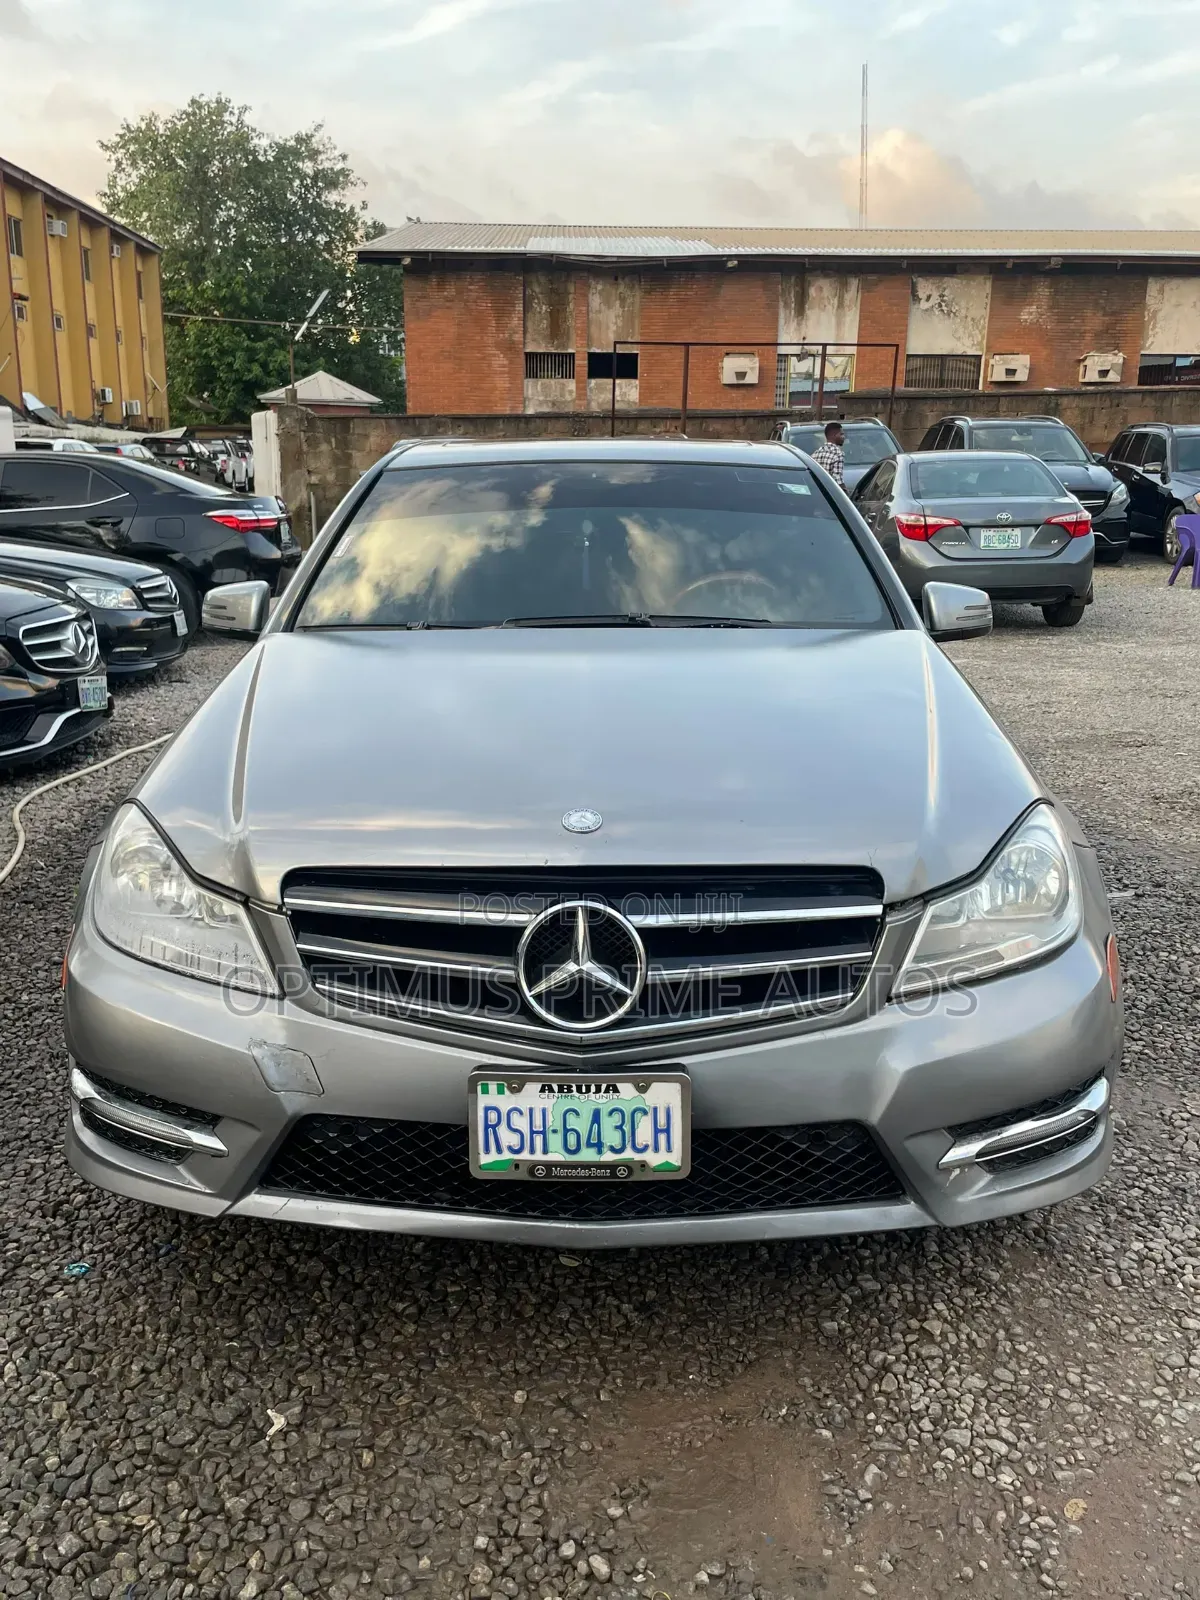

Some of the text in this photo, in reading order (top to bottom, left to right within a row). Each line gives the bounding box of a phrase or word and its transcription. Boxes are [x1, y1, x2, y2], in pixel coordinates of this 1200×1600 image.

[538, 1084, 621, 1094] ABUJA
[482, 1105, 673, 1155] RSH-643CH
[551, 1167, 611, 1178] Mercedes-Benz
